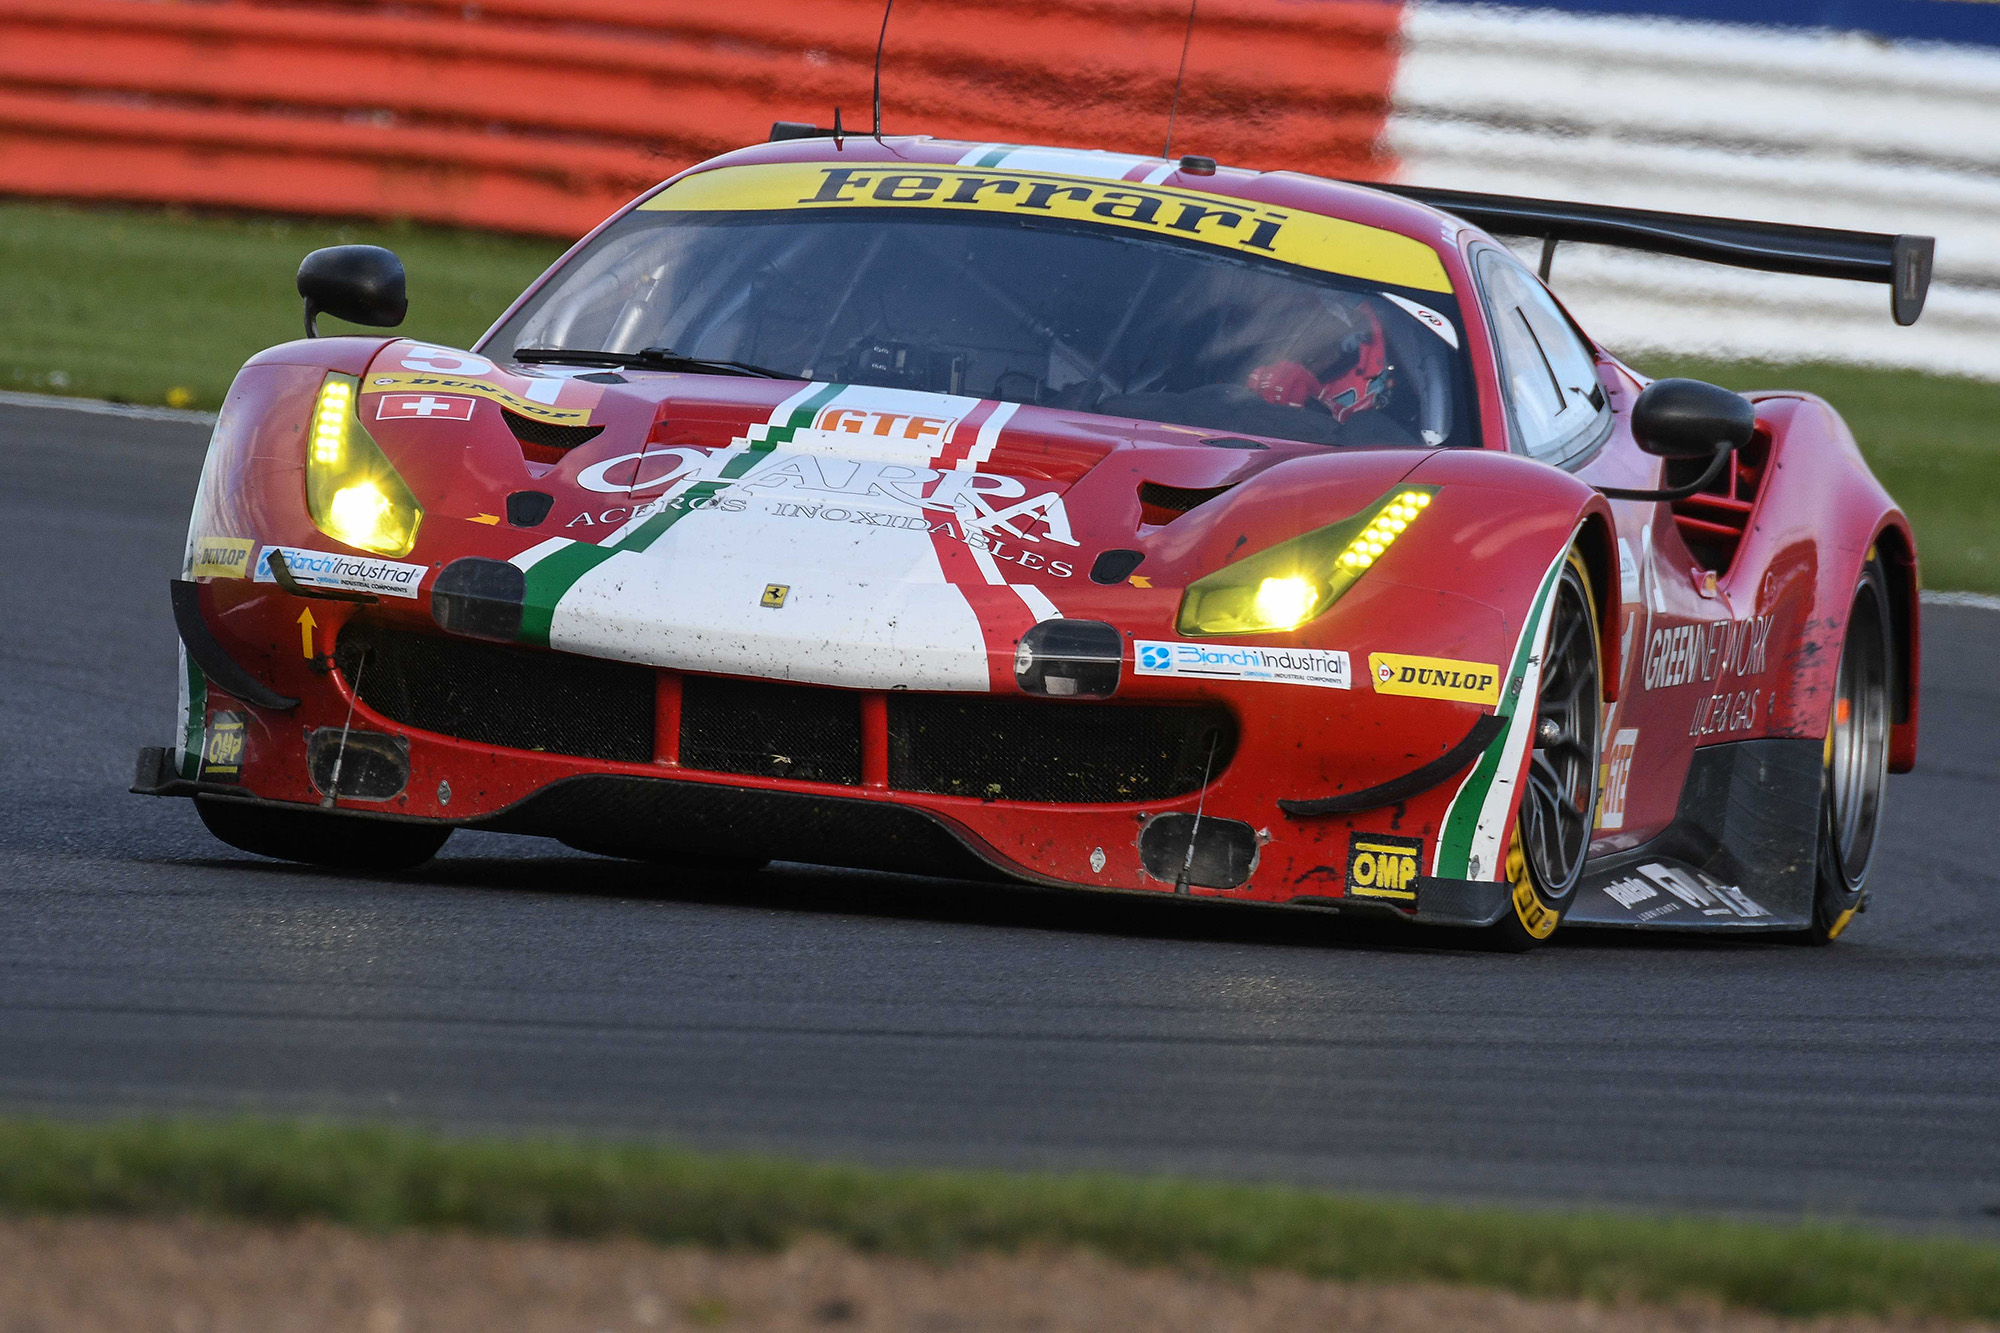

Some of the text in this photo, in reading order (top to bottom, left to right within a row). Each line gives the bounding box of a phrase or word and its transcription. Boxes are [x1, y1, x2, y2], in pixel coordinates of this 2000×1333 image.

[798, 167, 1288, 253] Ferrari
[406, 377, 581, 420] DUNLOP
[577, 447, 1081, 547] OLARRA
[565, 496, 1074, 578] ACEROS INOXIDABLES
[200, 547, 247, 566] DUNLOP
[281, 550, 416, 584] Bianchi Industrial
[371, 583, 408, 593] COMPONENTS
[1177, 645, 1342, 674] Bianchi Industrial
[1398, 666, 1493, 691] DUNLOP
[1729, 688, 1760, 732] GAS
[209, 732, 242, 764] OMP
[1353, 852, 1416, 890] OMP
